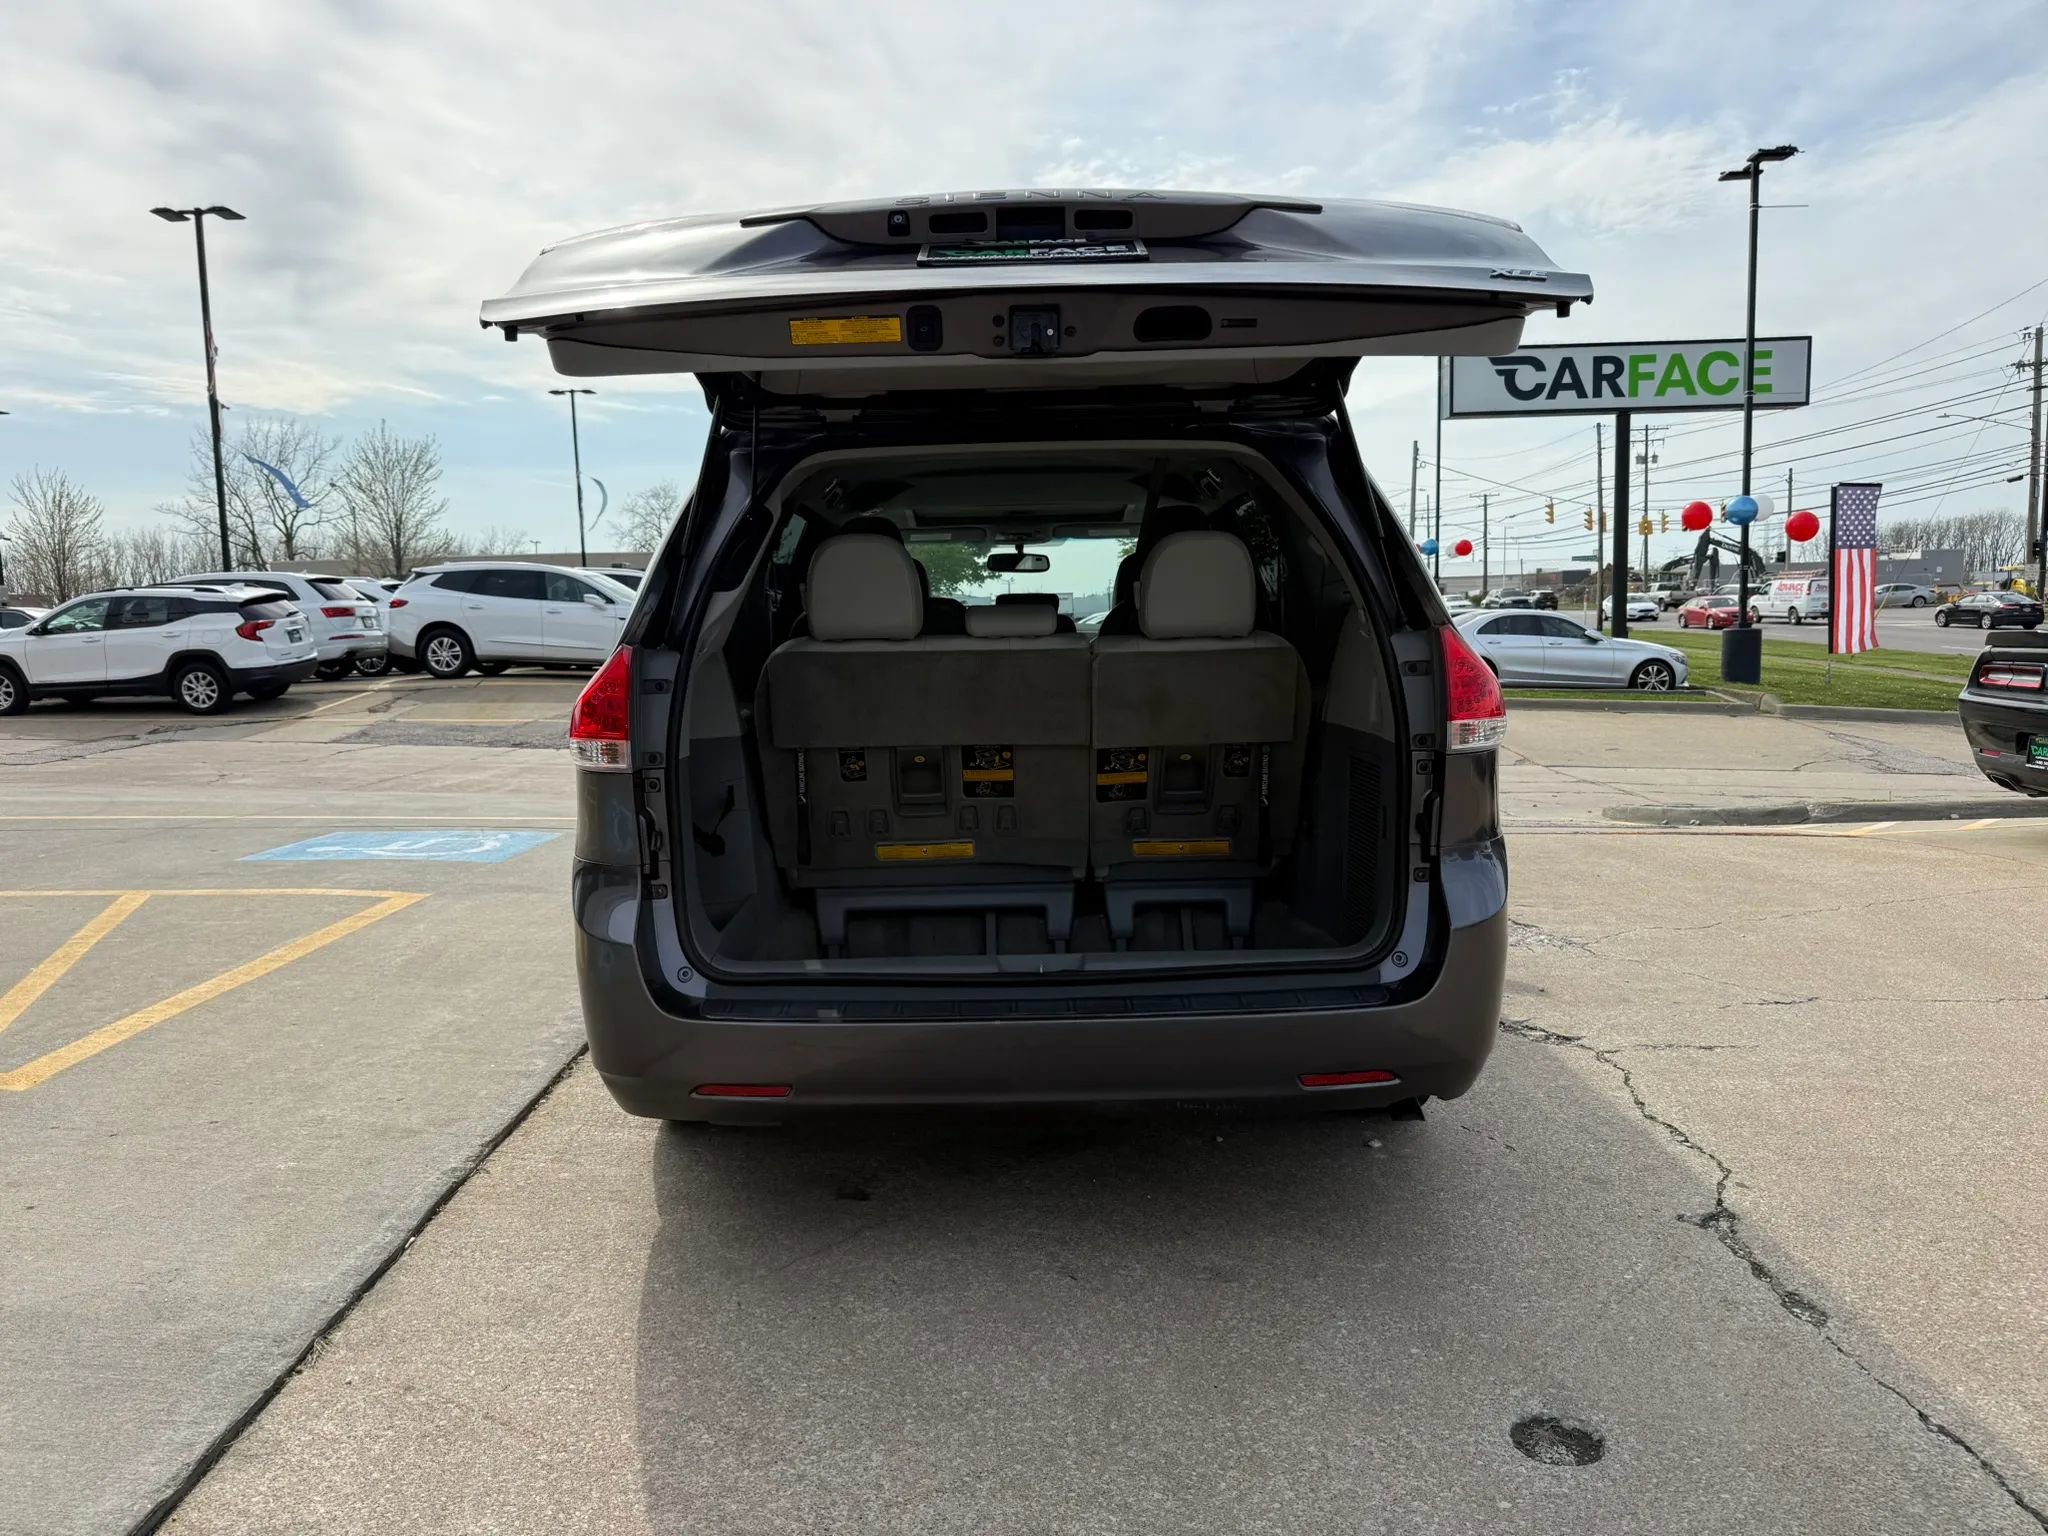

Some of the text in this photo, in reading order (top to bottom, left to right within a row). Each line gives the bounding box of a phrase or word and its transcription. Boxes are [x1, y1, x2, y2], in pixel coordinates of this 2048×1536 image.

[894, 190, 1168, 207] SIENNA
[1489, 267, 1548, 282] XLE
[1489, 349, 1774, 401] CARFACE
